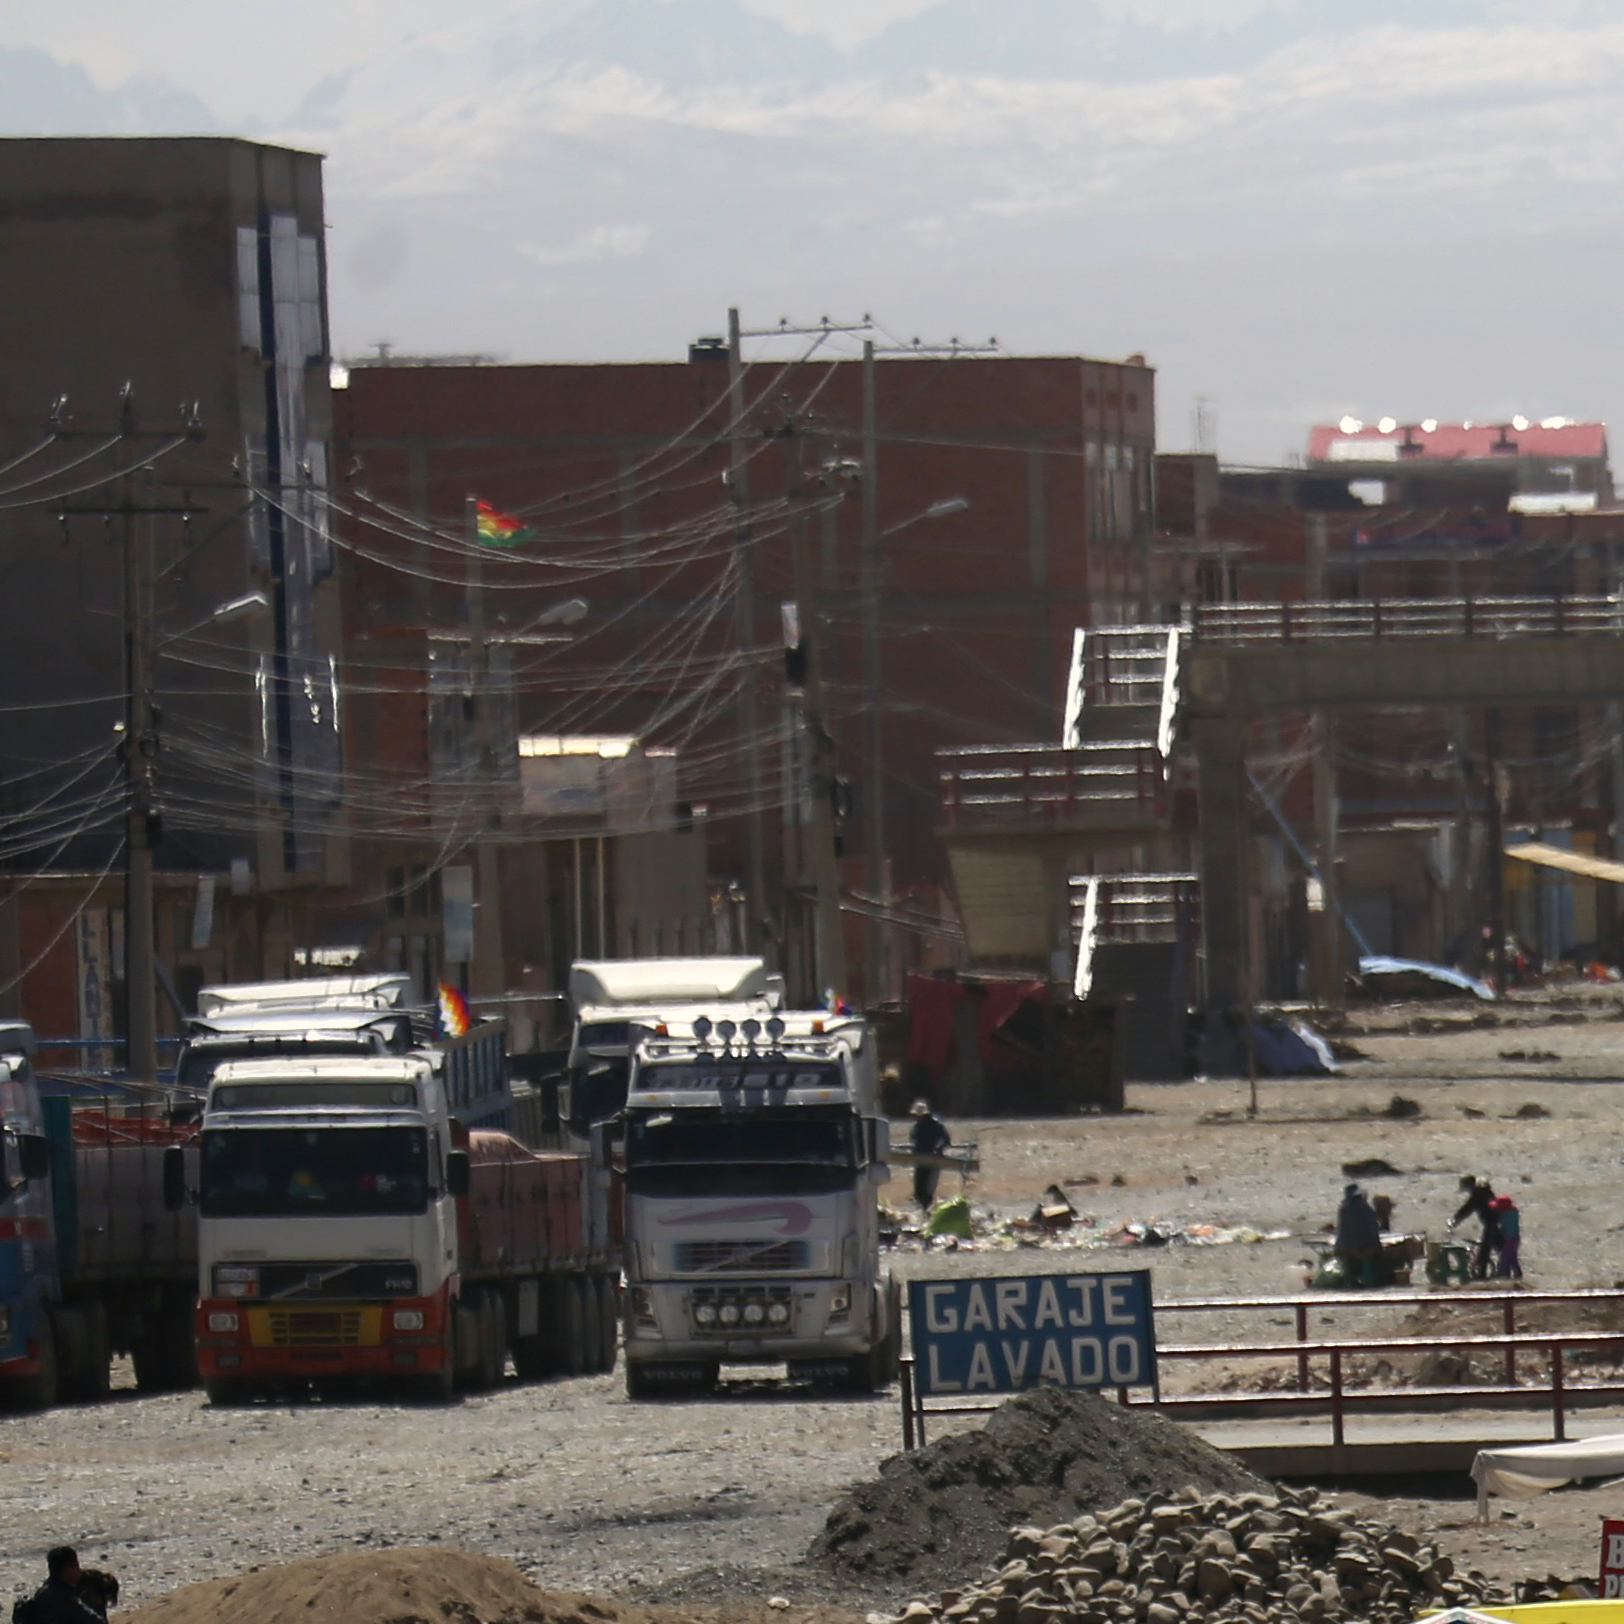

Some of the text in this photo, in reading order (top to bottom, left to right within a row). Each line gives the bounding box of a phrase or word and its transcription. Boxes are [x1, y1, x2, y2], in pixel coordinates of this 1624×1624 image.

[924, 1277, 1136, 1334] GARAJE
[643, 1370, 703, 1381] VOLVO
[929, 1336, 1139, 1392] LAVADO
